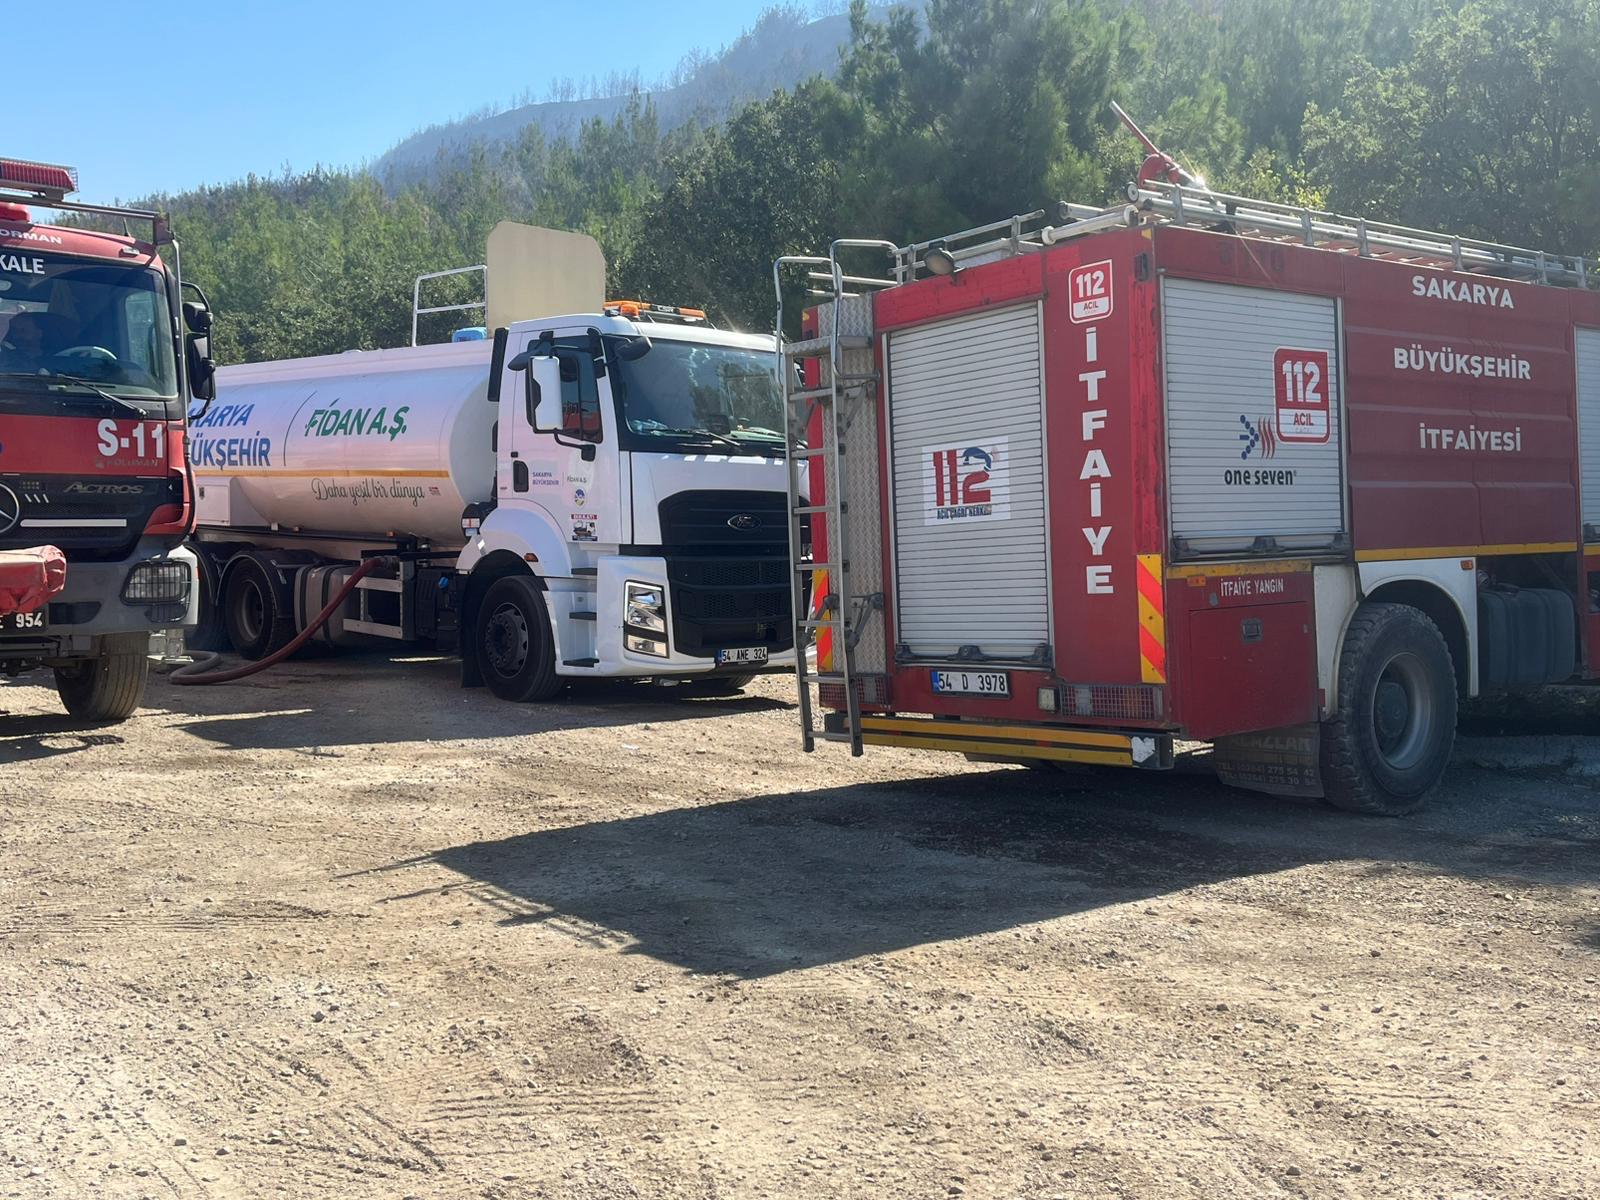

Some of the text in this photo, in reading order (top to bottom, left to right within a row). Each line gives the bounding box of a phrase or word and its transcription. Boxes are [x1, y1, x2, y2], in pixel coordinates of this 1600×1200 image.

[0, 228, 62, 245] ORMAN
[1075, 270, 1105, 298] 112
[1411, 275, 1514, 309] SAKARYA
[1394, 343, 1531, 380] BÜYÜKŞEHİR
[1282, 360, 1322, 403] 112
[304, 398, 372, 437] FİDAN
[97, 418, 164, 459] S-11
[1419, 422, 1521, 452] İTFAİYESİ
[1078, 326, 1114, 595] İTFAİYE
[311, 477, 348, 501] Daha
[348, 477, 372, 506] yeşil
[371, 477, 389, 499] bir
[389, 477, 425, 507] dünya
[932, 447, 993, 507] 112
[1224, 469, 1251, 486] one
[1220, 577, 1284, 597] İTFAİYE YANGIN
[15, 612, 43, 628] 954
[721, 650, 732, 662] 54
[753, 647, 767, 659] 324
[938, 673, 1006, 692] 54 D 3978
